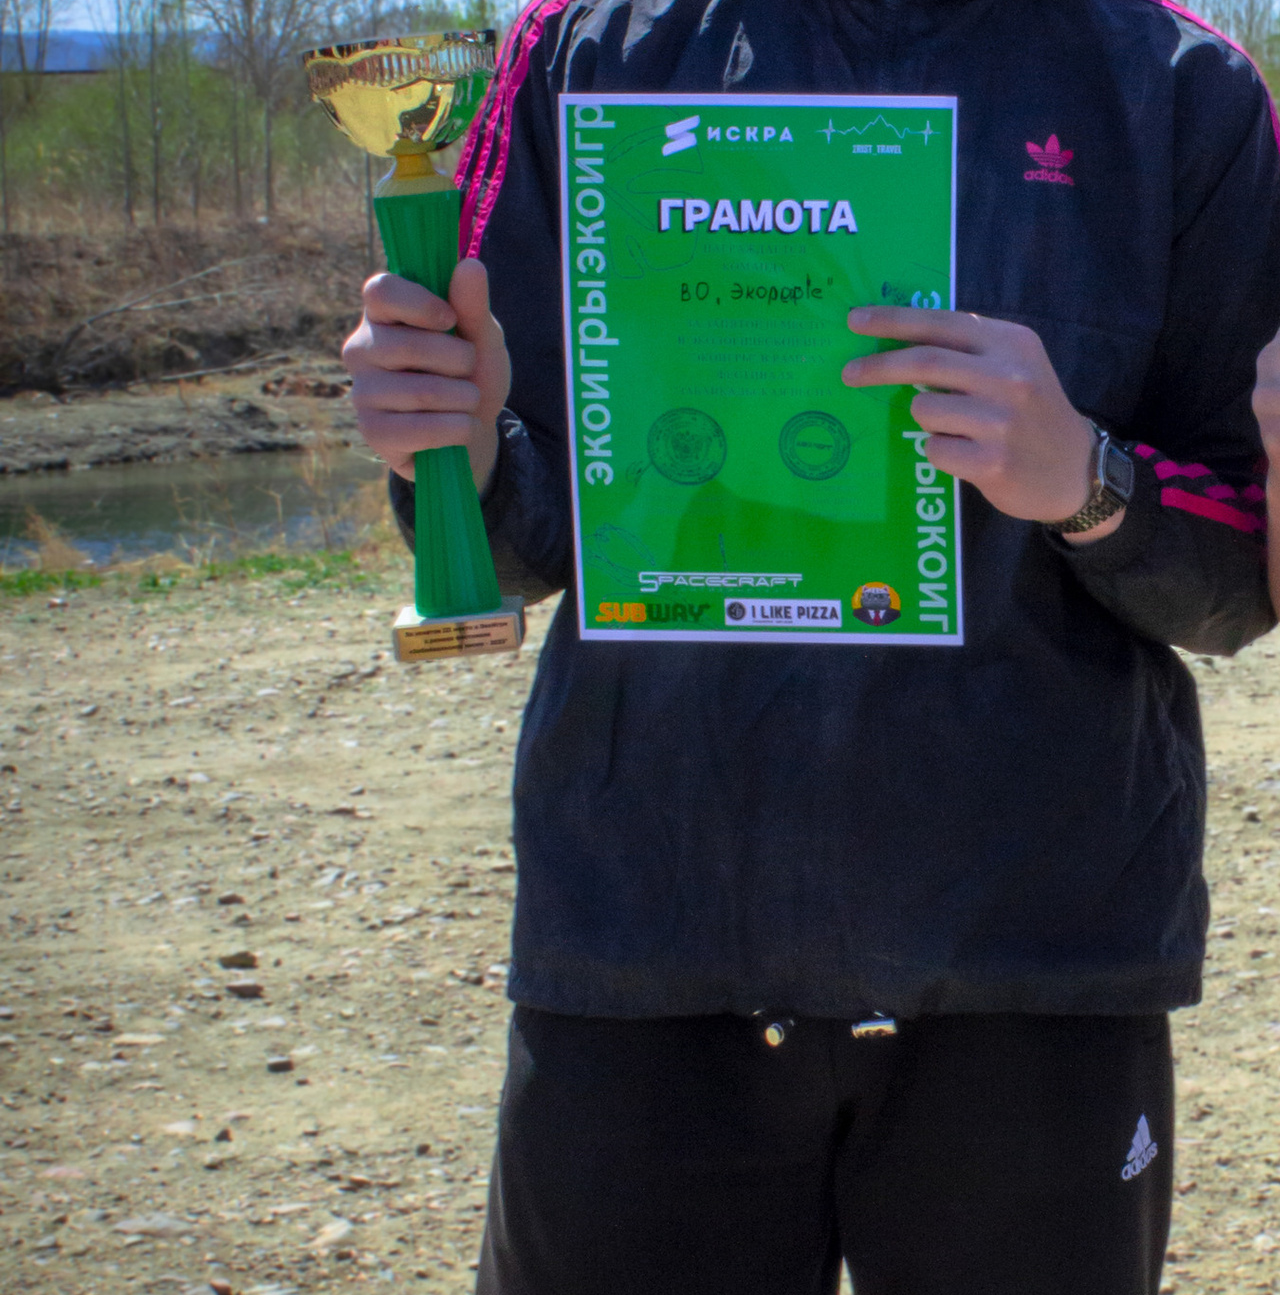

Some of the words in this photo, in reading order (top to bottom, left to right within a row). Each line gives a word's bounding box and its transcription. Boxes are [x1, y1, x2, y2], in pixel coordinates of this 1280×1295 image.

[707, 126, 794, 142] ИСКРА
[1023, 168, 1074, 186] adidas
[658, 198, 859, 234] ГРАМОТА
[594, 601, 711, 623] SUBWAY
[751, 605, 757, 619] I
[760, 605, 793, 620] LIKE
[797, 606, 839, 620] PIZZA
